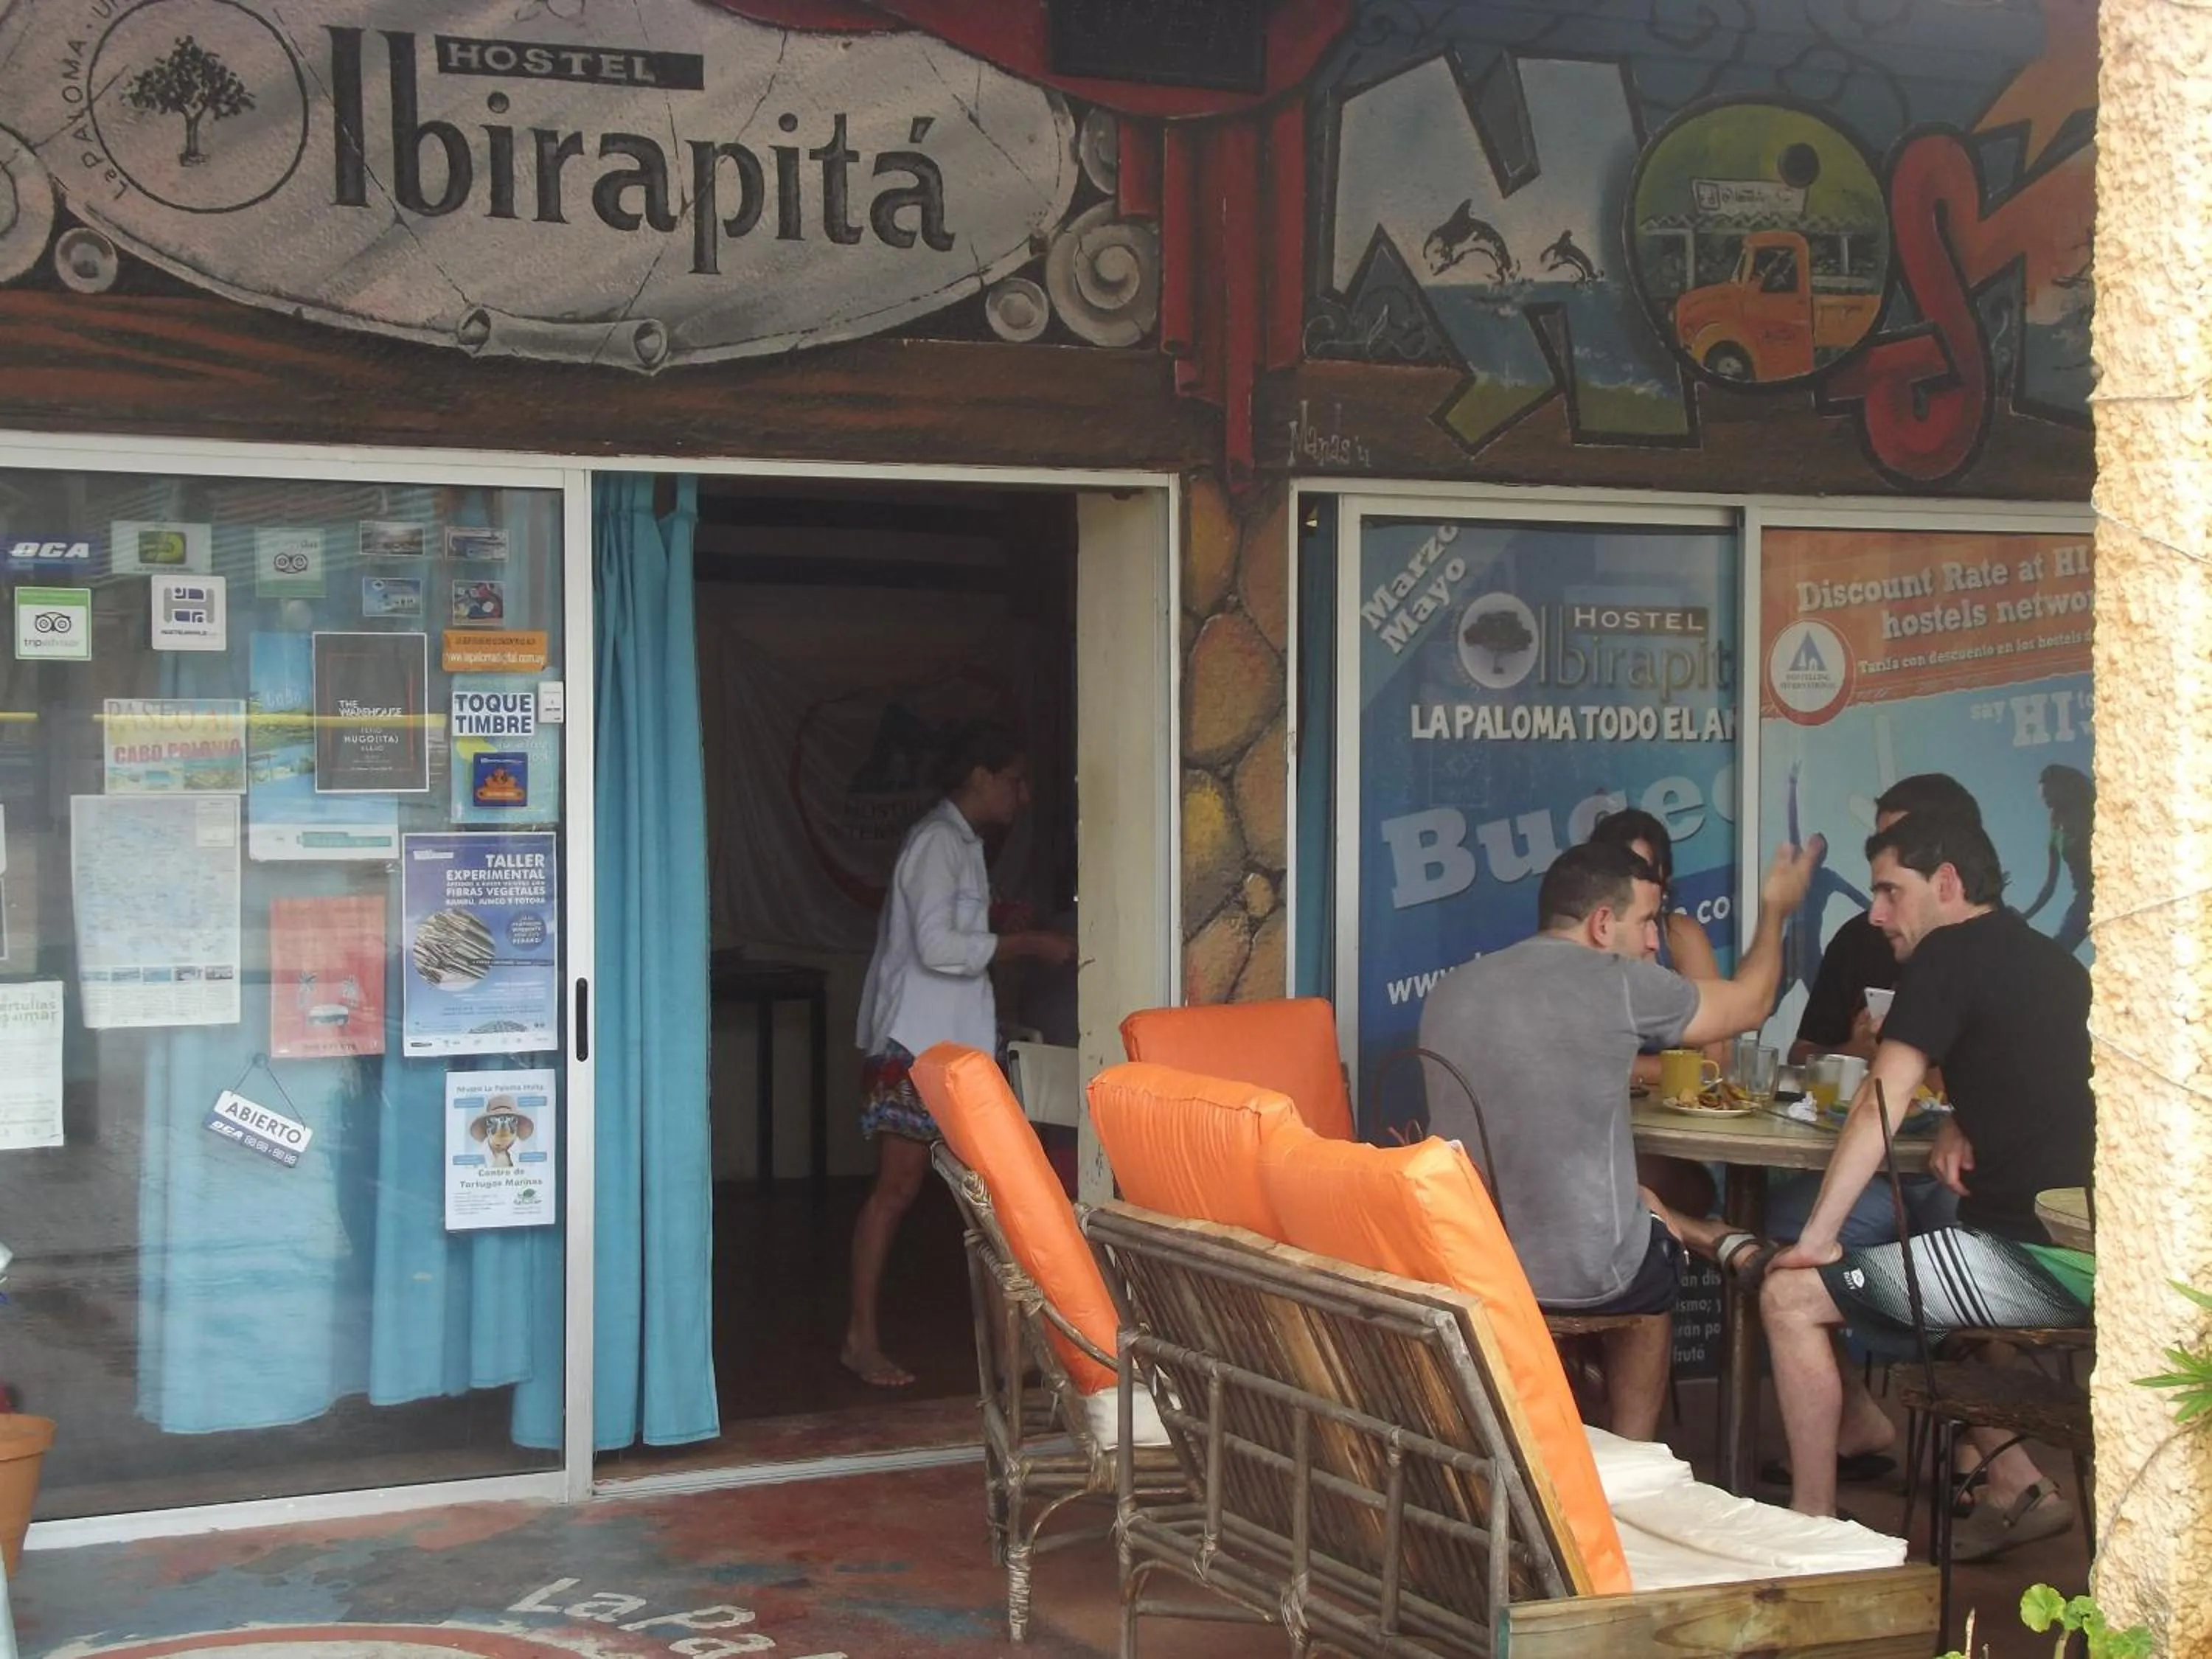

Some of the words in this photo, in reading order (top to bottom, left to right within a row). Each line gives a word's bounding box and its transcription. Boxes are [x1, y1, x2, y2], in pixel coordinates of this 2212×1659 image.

[447, 42, 656, 84] HOSTEL
[321, 24, 956, 275] Ibirapitá
[1360, 524, 1460, 630] Marzo
[1796, 567, 1934, 613] Discount
[1941, 557, 2008, 593] Rate
[2018, 556, 2045, 582] at
[2053, 544, 2090, 578] HI
[1380, 557, 1466, 655] Mayo
[1574, 606, 1705, 631] HOSTEL
[1881, 598, 1989, 640] hostels
[1539, 605, 1736, 703] Ibirapit
[1858, 658, 1899, 674] Tarifa
[1902, 655, 1926, 668] con
[1928, 645, 1994, 664] descuento
[1997, 641, 2014, 655] en
[2017, 638, 2035, 651] los
[2038, 630, 2082, 648] hostels
[453, 694, 532, 713] TOQUE
[455, 714, 532, 734] TIMBRE
[1411, 703, 1450, 740] LA
[1454, 704, 1579, 740] PALOMA
[1580, 705, 1658, 741] TODO
[1663, 706, 1698, 741] EL
[1969, 701, 2006, 724] say
[2009, 690, 2076, 747] HI
[446, 869, 546, 881] EXPERIMENTAL
[485, 853, 546, 868] TALLER
[446, 887, 483, 897] FIBRAS
[486, 886, 546, 896] VEGETALES
[225, 1102, 302, 1144] ABIERTO
[507, 1576, 647, 1623] La
